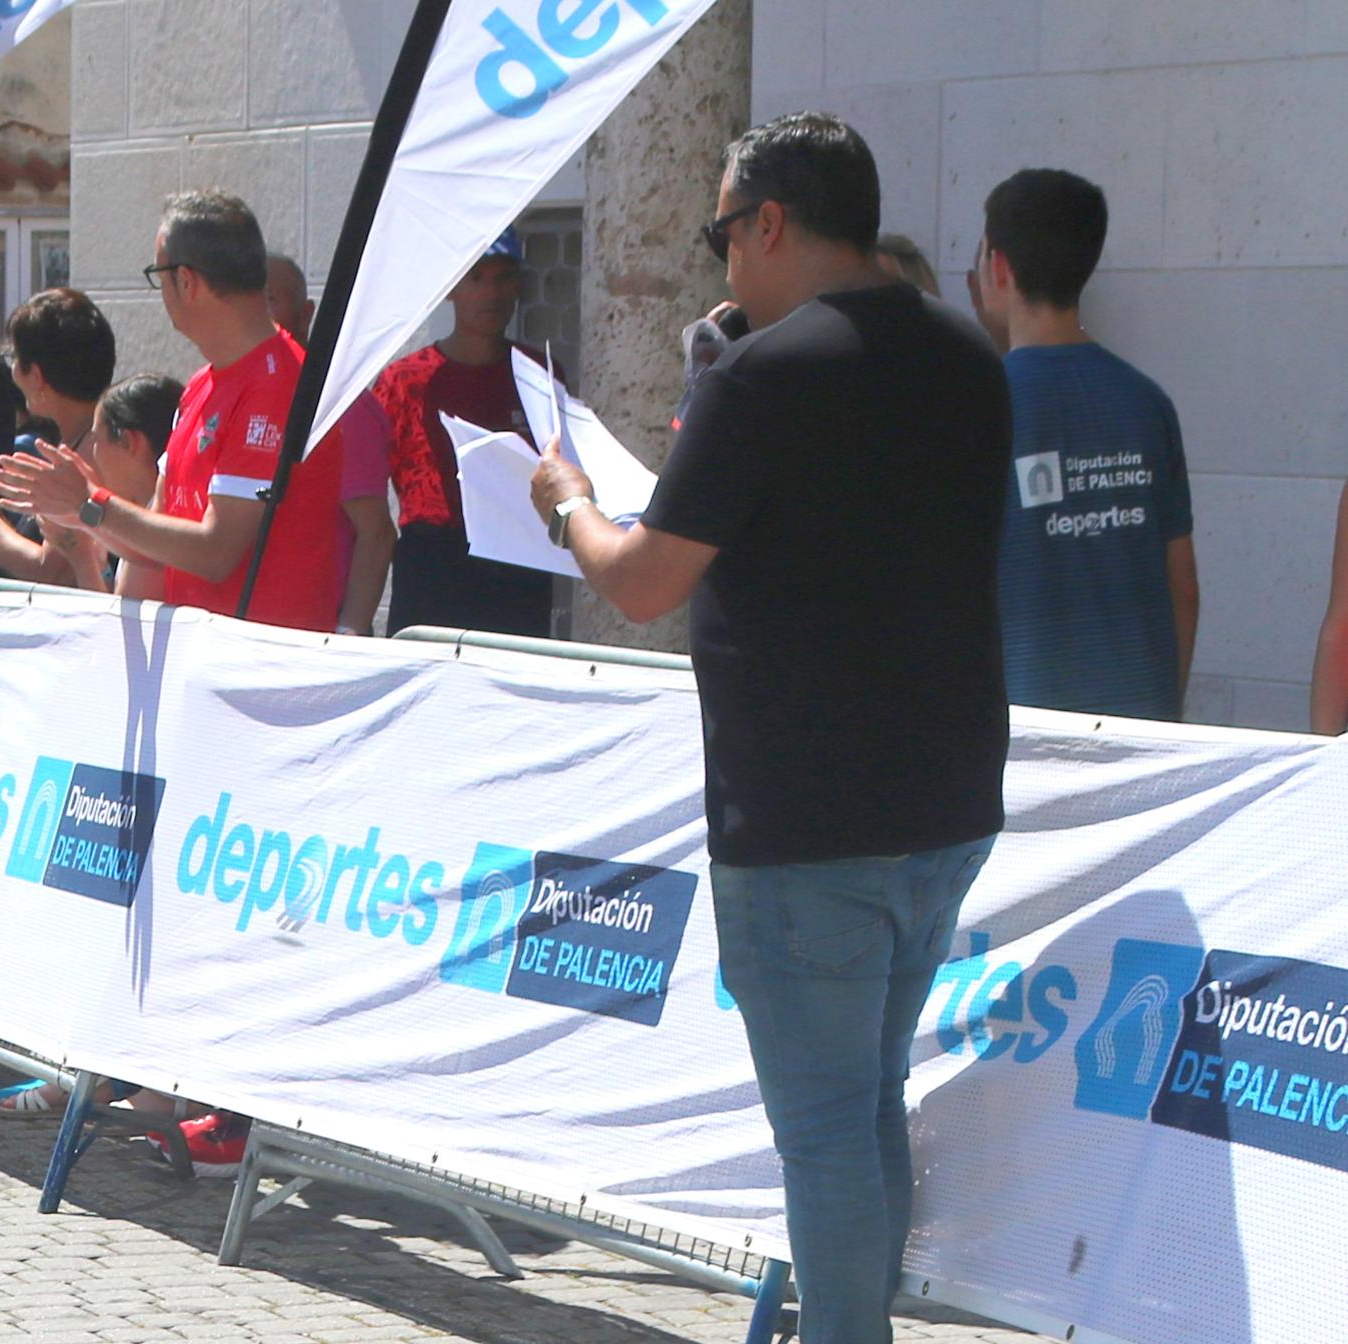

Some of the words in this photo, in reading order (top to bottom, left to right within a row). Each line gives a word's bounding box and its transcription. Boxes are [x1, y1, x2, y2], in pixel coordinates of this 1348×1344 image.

[475, 0, 670, 119] de
[1066, 451, 1143, 473] Diputación
[1068, 476, 1086, 492] DE
[1046, 505, 1146, 538] deportes
[66, 788, 137, 830] Diputación
[52, 836, 76, 866] DE
[74, 841, 137, 883] PALENCIA
[176, 792, 445, 947] deportes
[531, 878, 655, 934] Diputación
[518, 935, 553, 975] DE
[555, 940, 666, 996] PALENCIA
[1195, 980, 1348, 1055] Diputació
[1170, 1049, 1224, 1099] DE
[1221, 1060, 1348, 1133] PALENC
